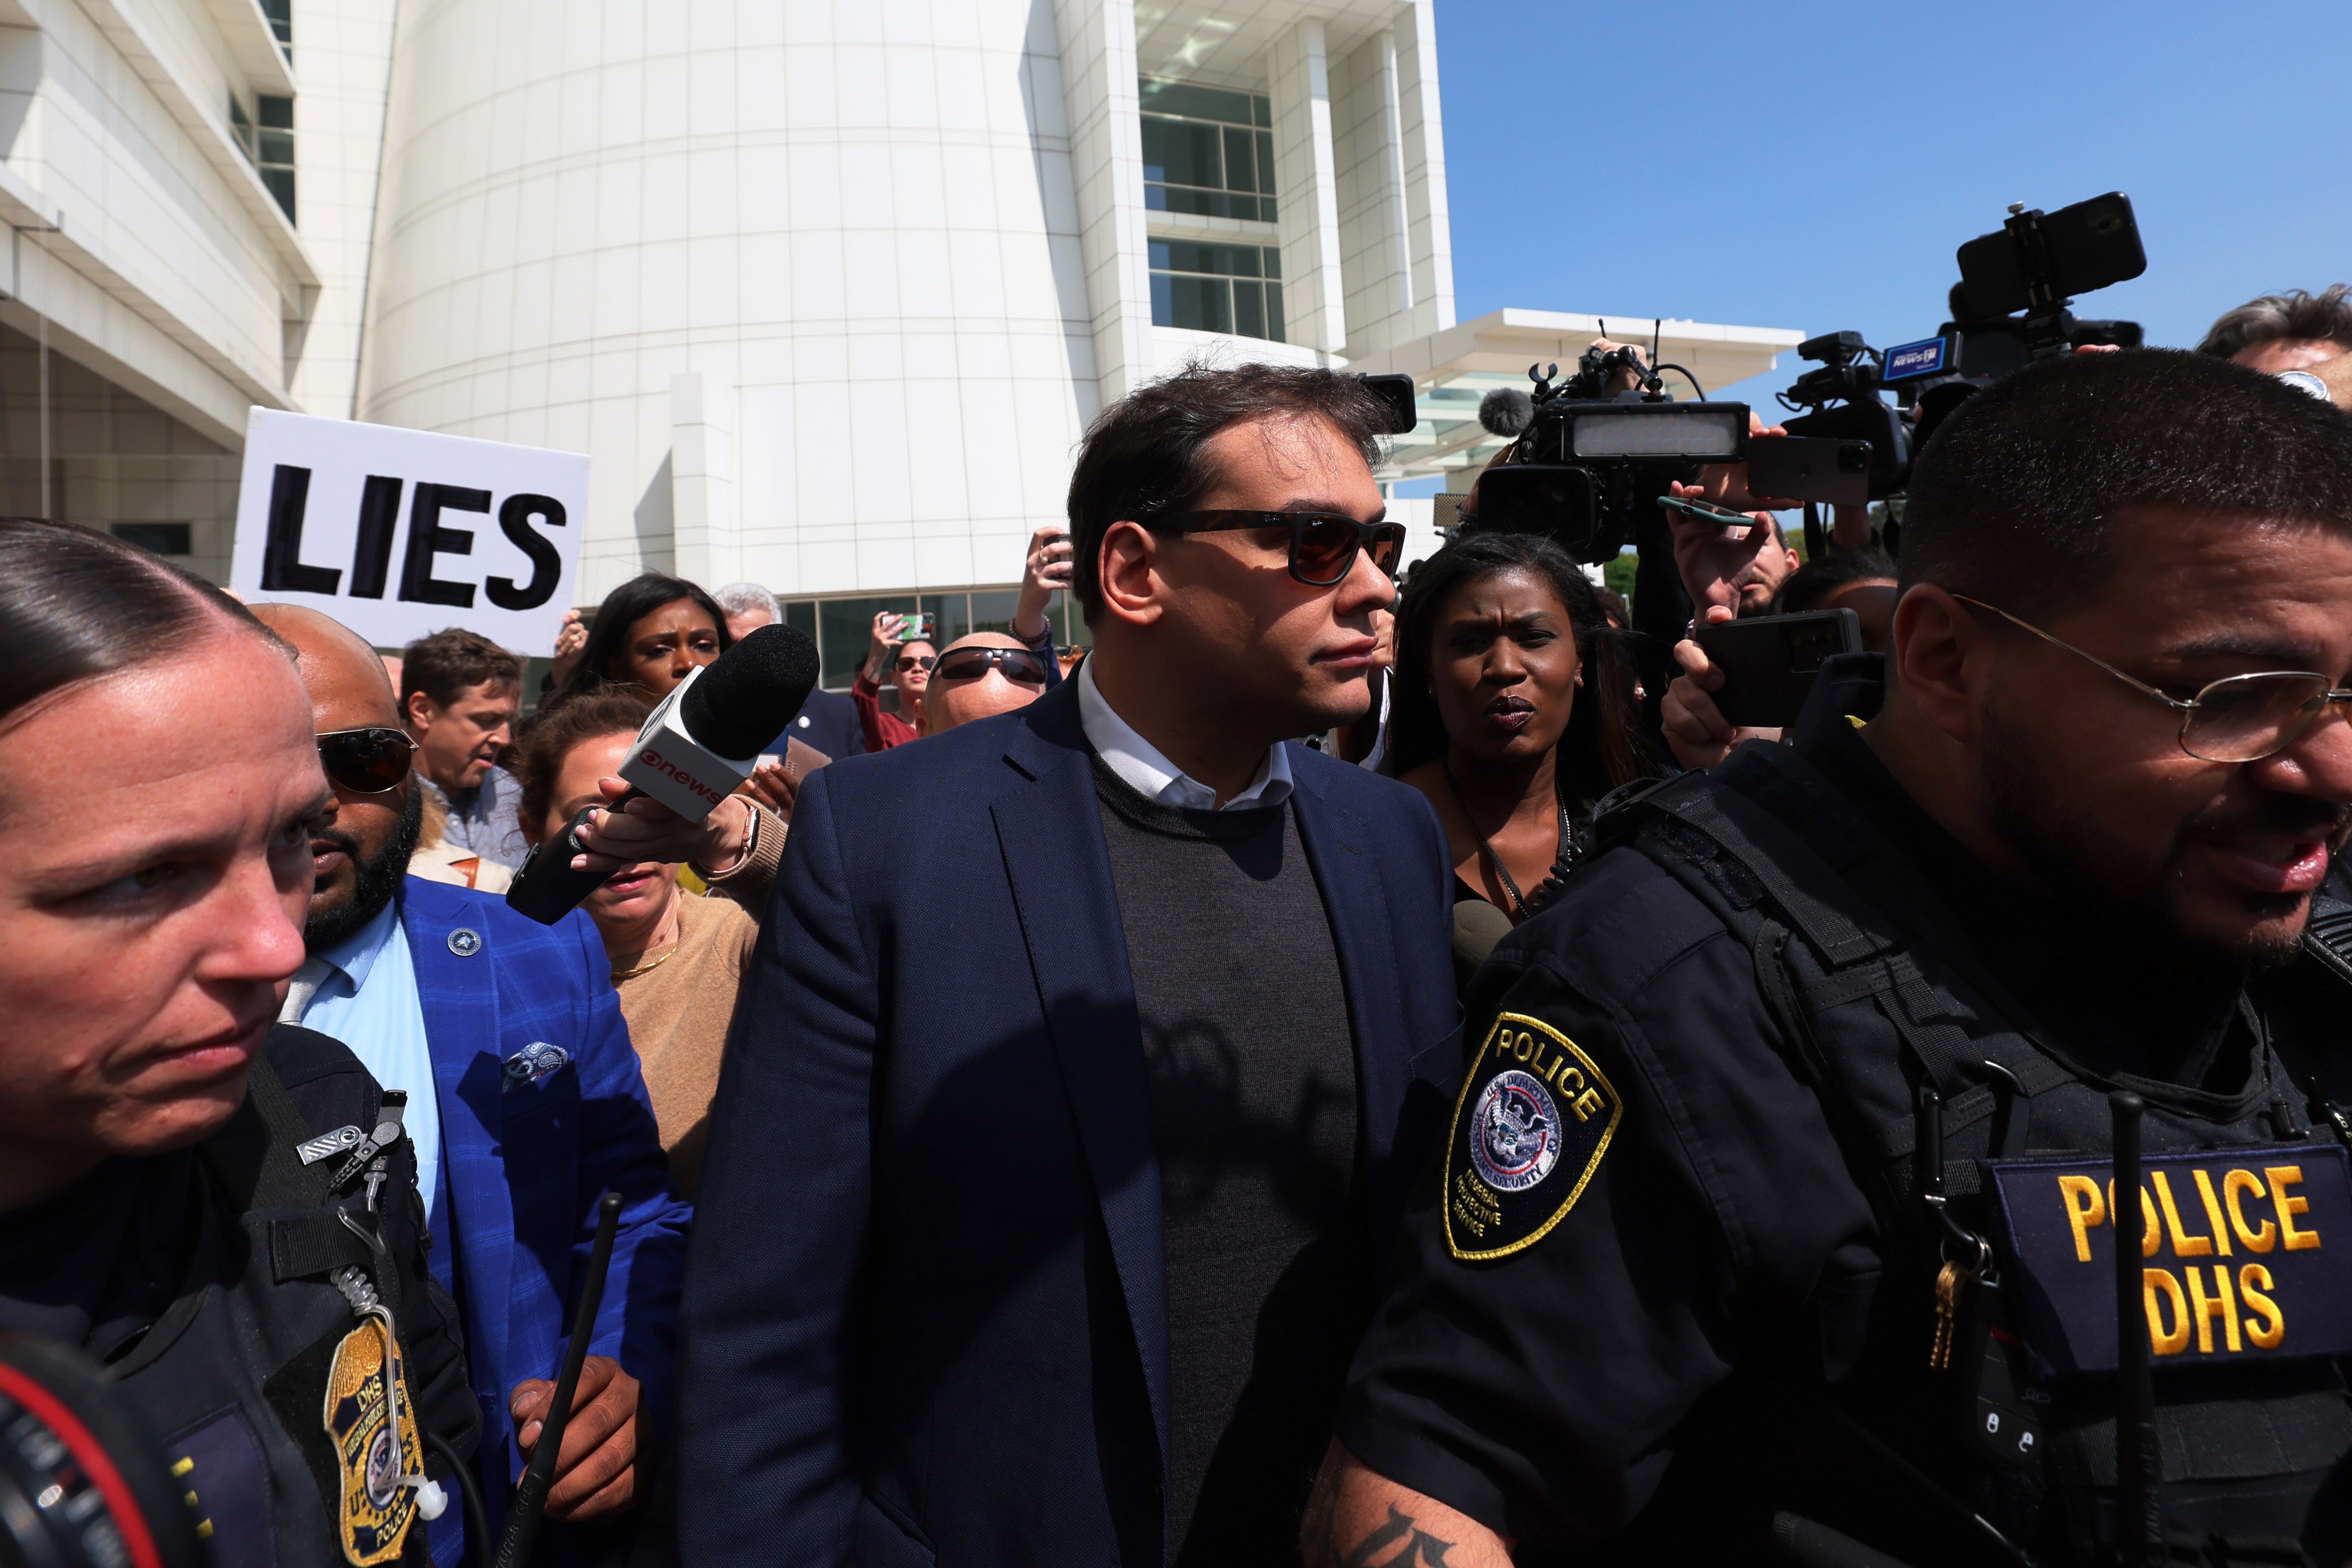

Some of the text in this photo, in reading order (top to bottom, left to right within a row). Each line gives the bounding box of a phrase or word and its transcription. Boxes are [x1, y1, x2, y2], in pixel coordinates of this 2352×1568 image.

[261, 464, 567, 611] LIES
[1495, 1028, 1606, 1123] POLICE
[1465, 1169, 1500, 1208] FEDERAL
[1493, 1164, 1544, 1188] SECURITY
[1453, 1199, 1485, 1237] SERVICE
[1455, 1174, 1501, 1226] PROTECTIVE
[2144, 1263, 2285, 1356] DHS
[356, 1375, 383, 1412] DHS
[376, 1502, 407, 1548] POLICE
